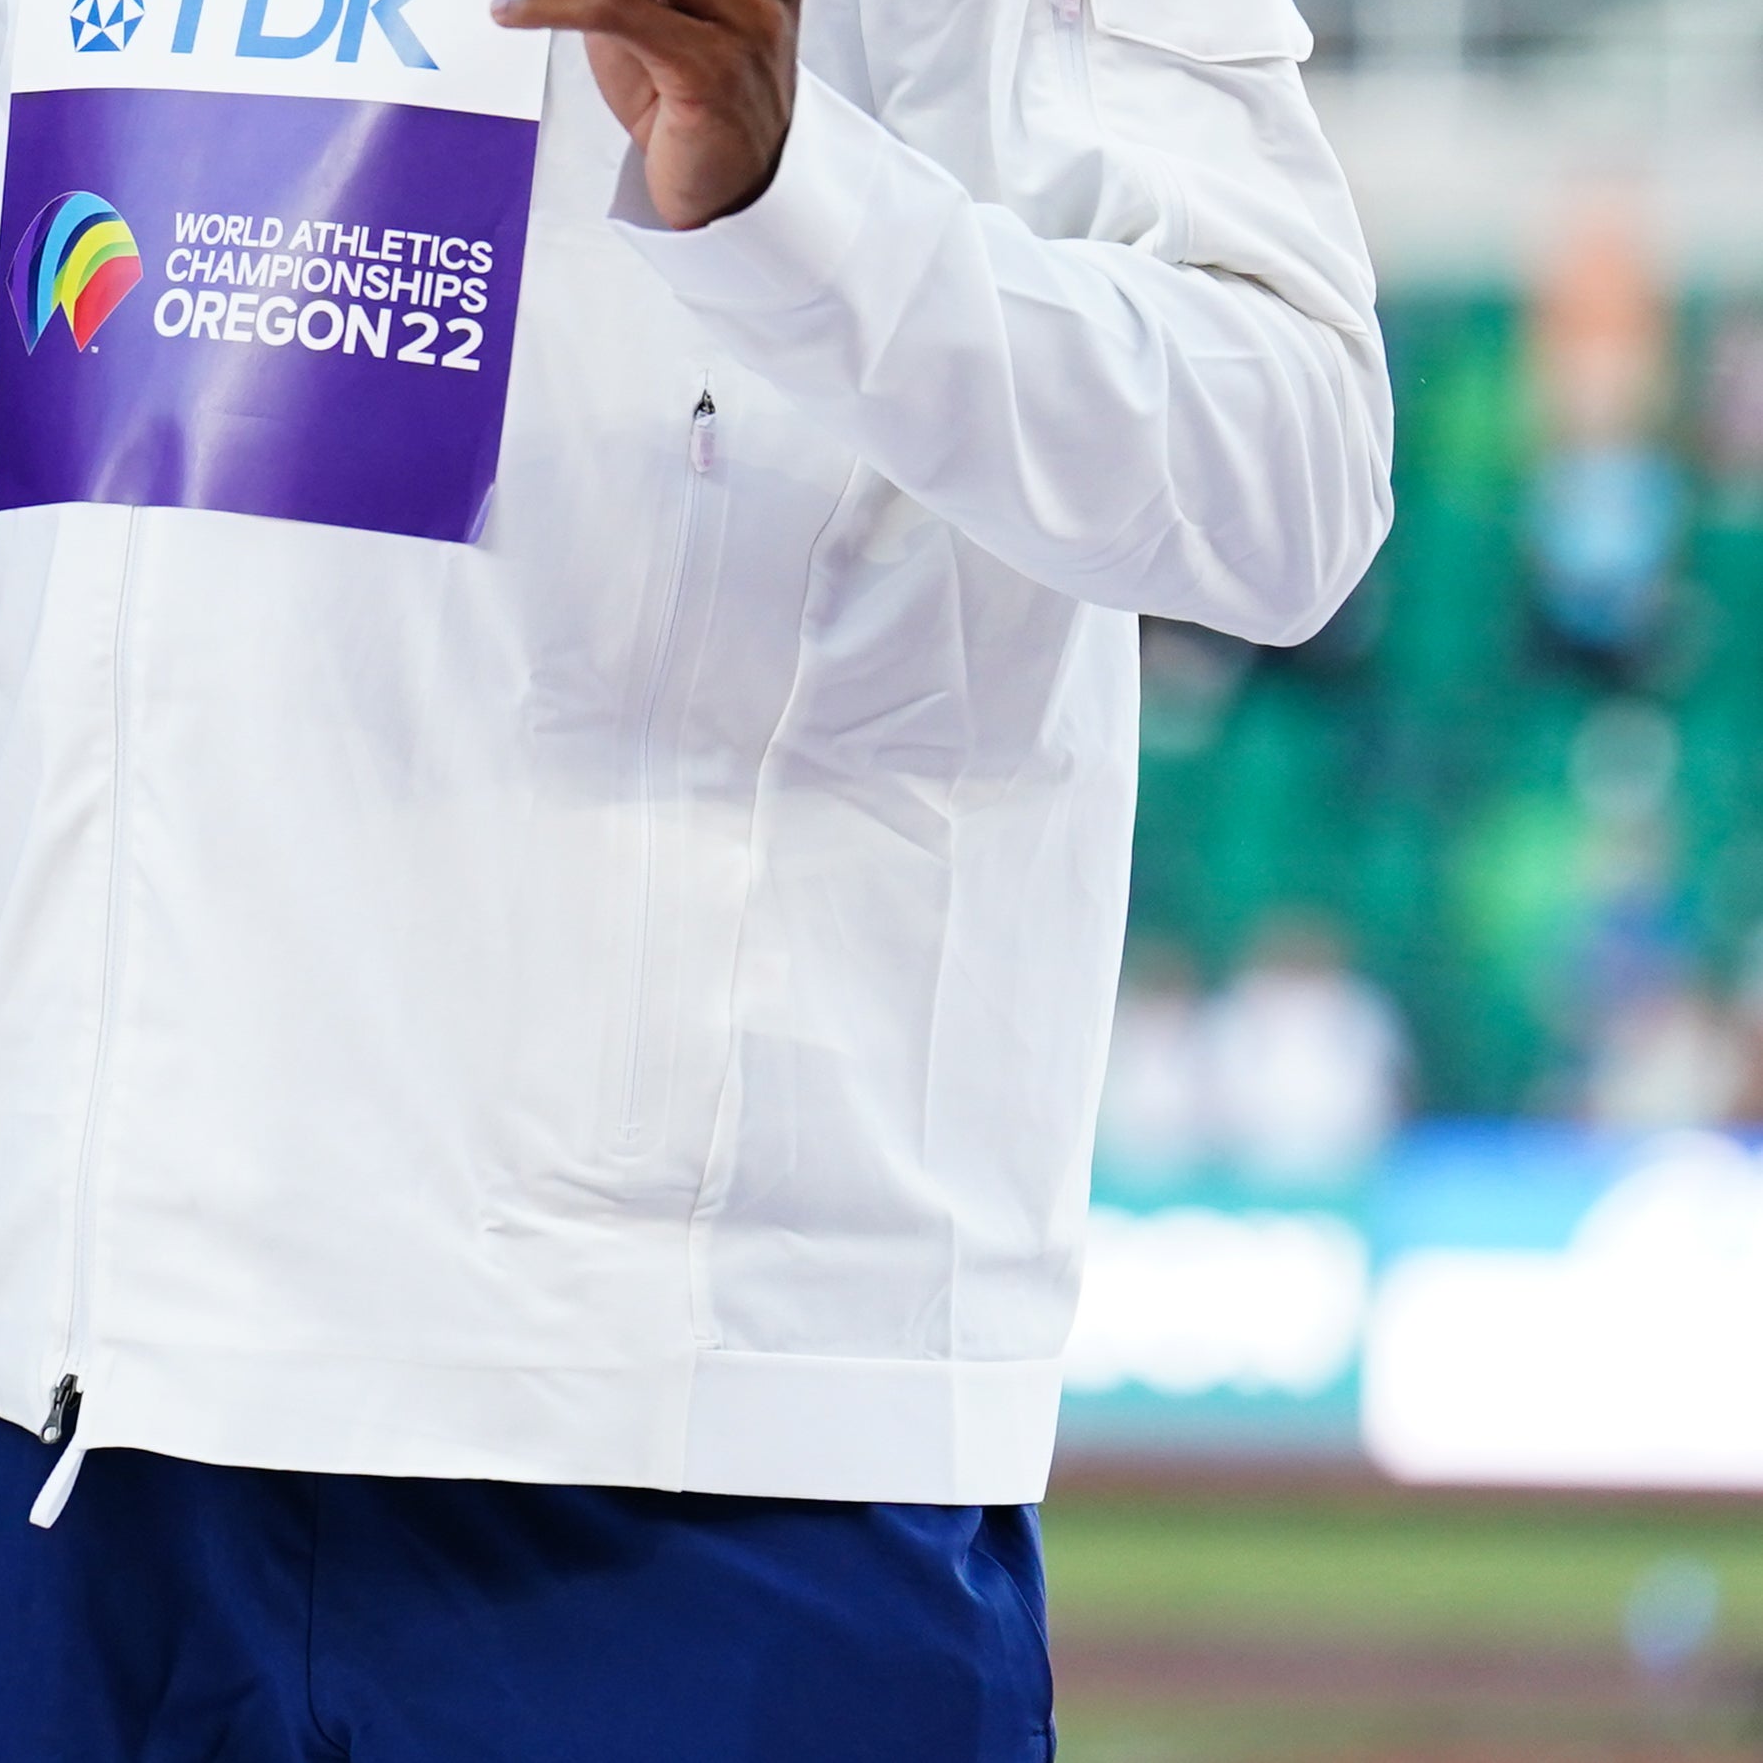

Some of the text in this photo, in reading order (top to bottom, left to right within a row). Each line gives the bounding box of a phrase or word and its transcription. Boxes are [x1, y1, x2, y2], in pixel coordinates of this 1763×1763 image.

[175, 212, 493, 274] WORLD ATHLETICS
[165, 248, 488, 314] CHAMPIONSHIPS
[153, 288, 484, 372] OREGON 22
